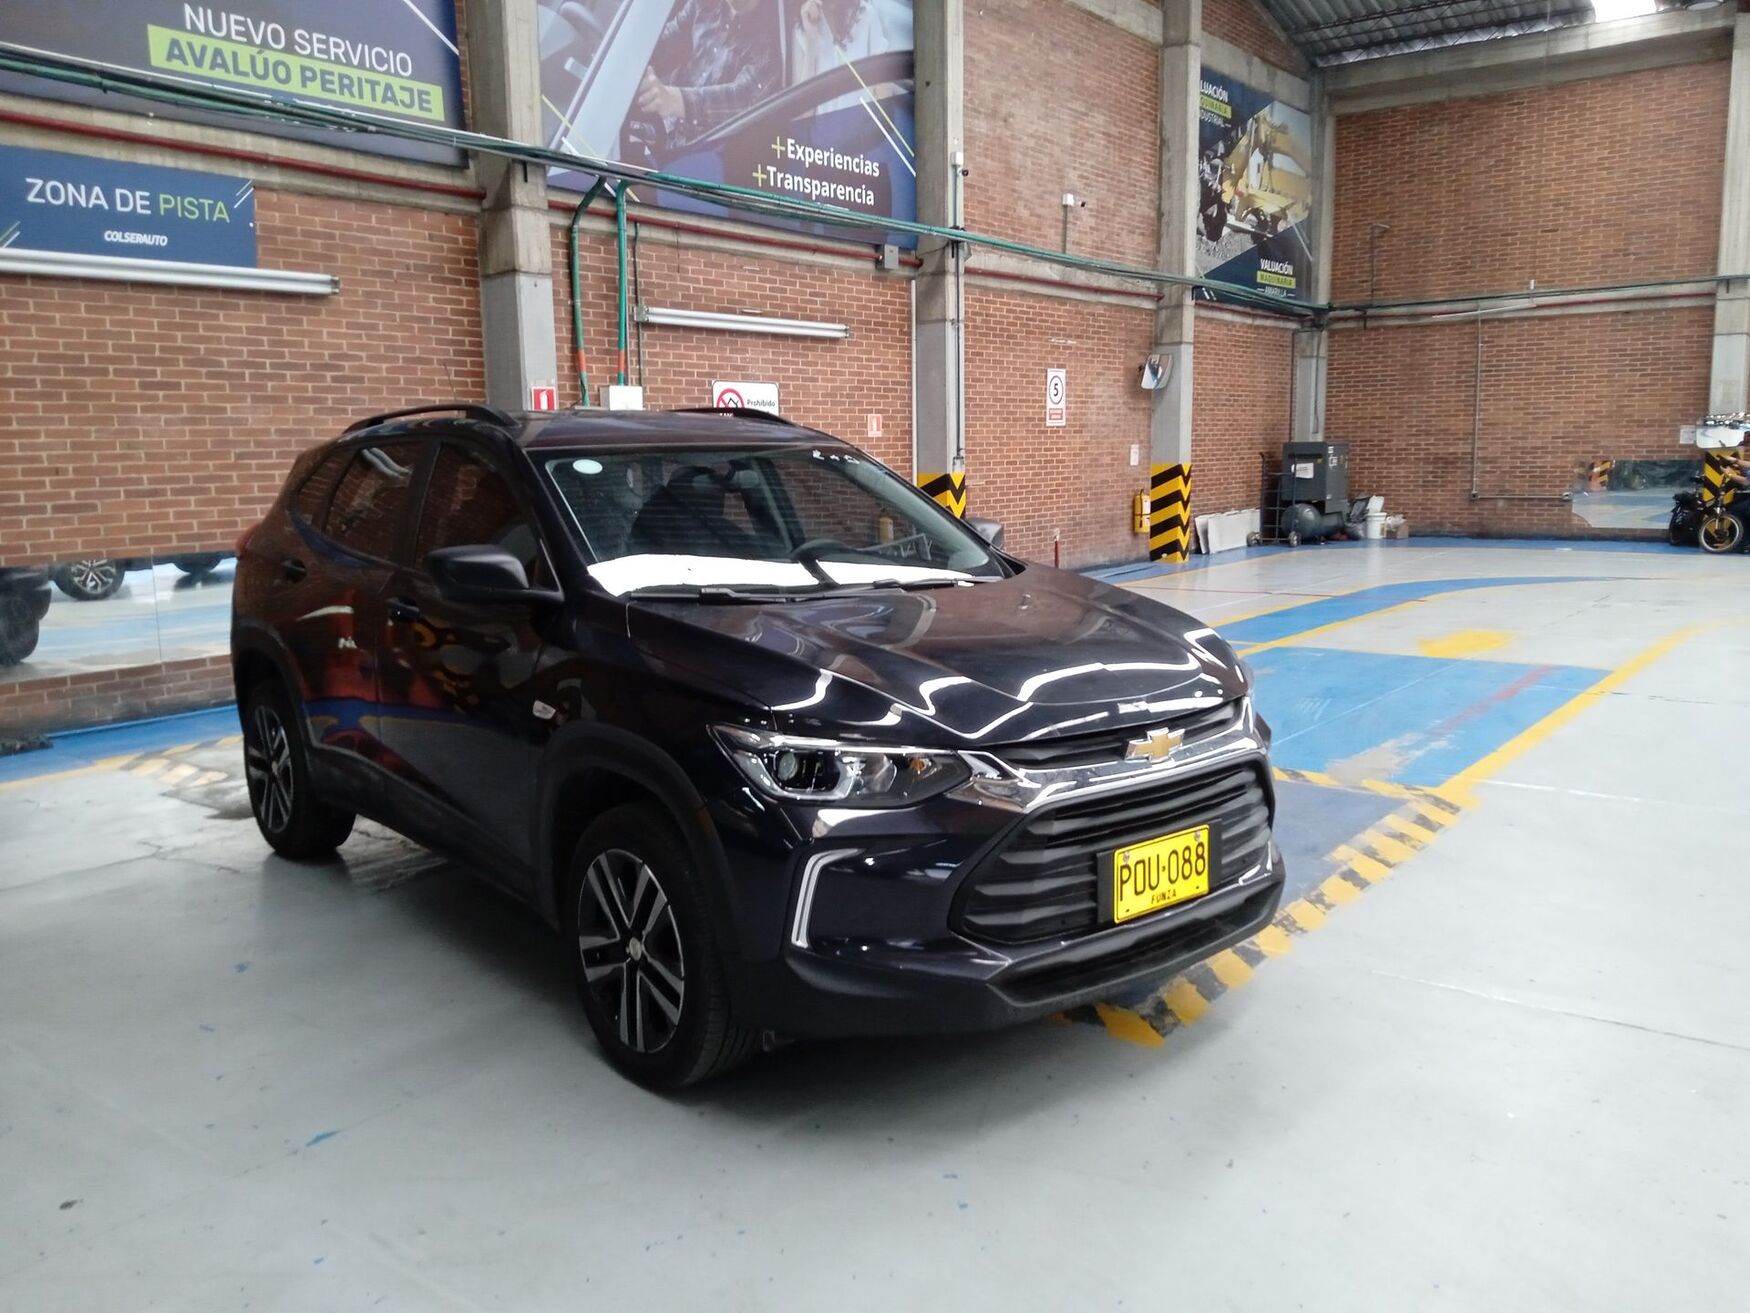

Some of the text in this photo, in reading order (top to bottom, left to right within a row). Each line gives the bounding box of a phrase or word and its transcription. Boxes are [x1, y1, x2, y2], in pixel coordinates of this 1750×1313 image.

[183, 3, 413, 77] NUEVO SERVICIO
[166, 37, 432, 113] AVALÚO PERITAJE
[1200, 80, 1229, 103] LUACIÓN
[25, 178, 230, 223] ZONA DE PISTA
[104, 229, 168, 247] COLSERAUTO
[1260, 258, 1294, 276] VALUACIÓN
[1053, 382, 1059, 397] 5
[746, 398, 776, 408] Prohibido
[1150, 889, 1178, 905] FUNZA
